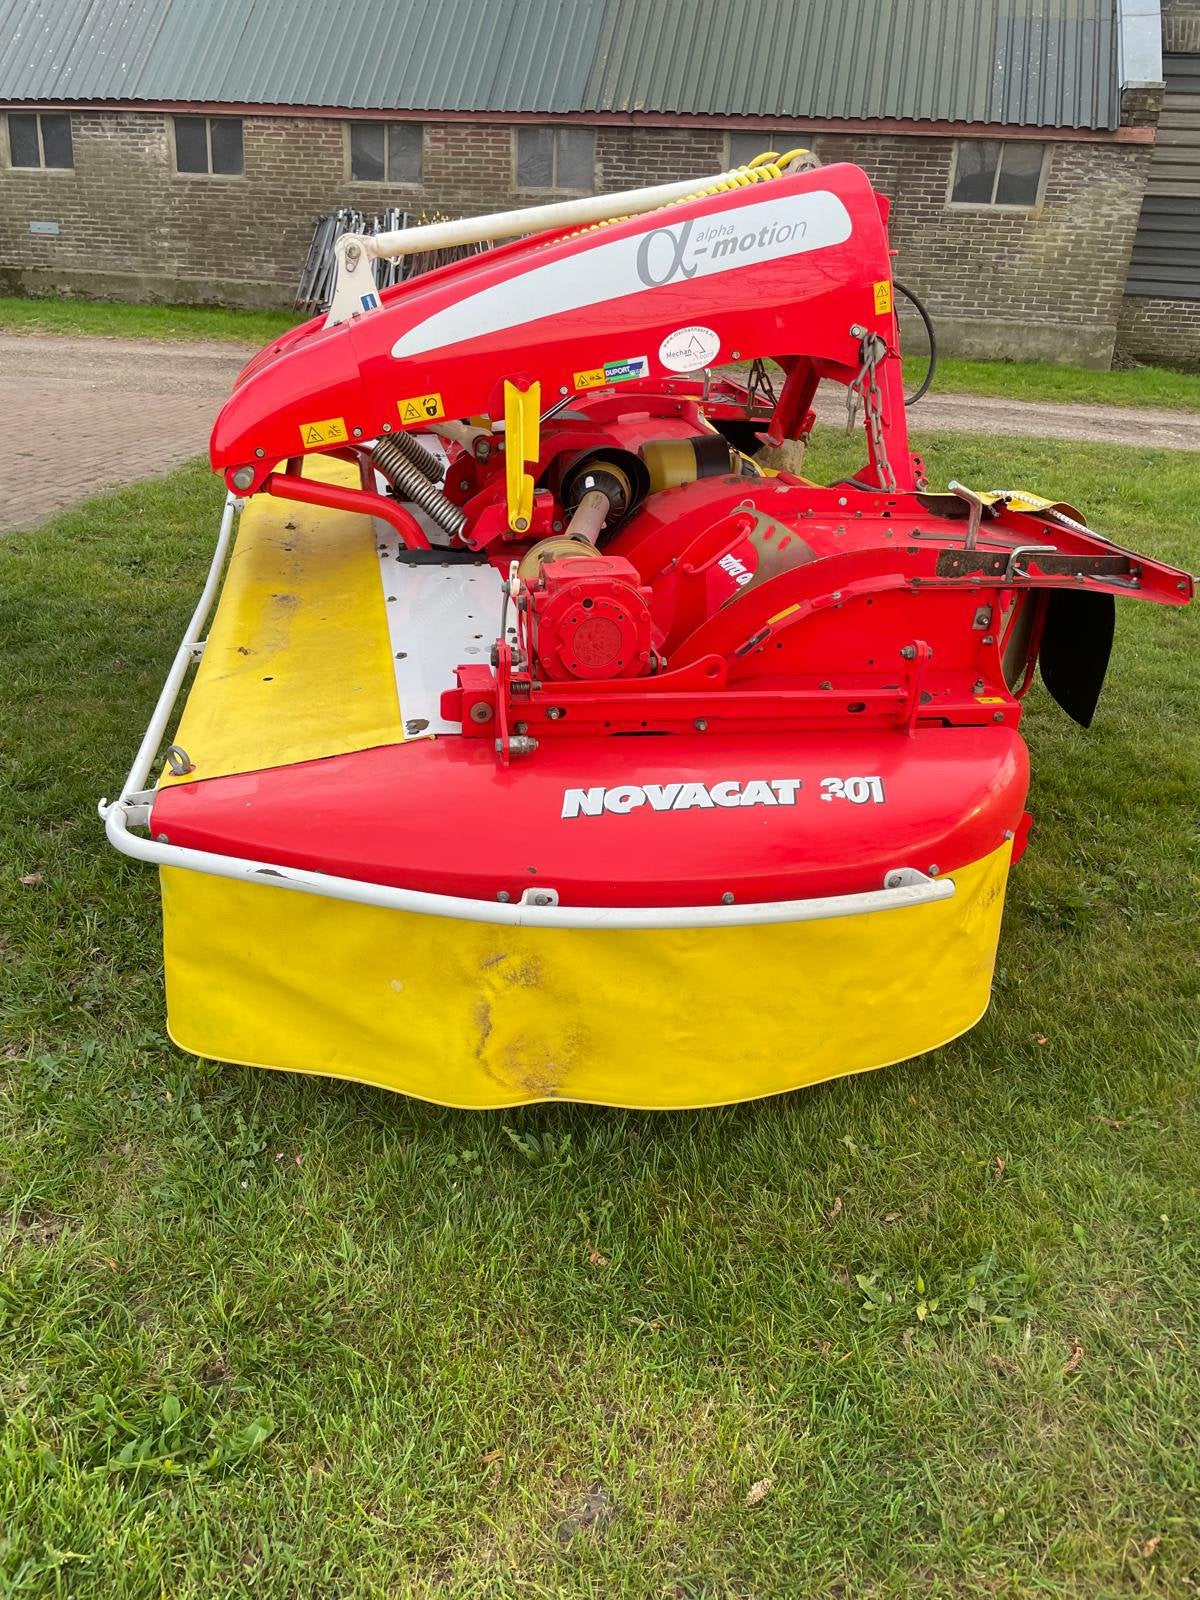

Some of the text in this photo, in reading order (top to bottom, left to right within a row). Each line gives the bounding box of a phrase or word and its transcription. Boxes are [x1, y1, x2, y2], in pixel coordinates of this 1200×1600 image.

[696, 224, 735, 243] alpha
[666, 348, 692, 359] Mechan
[605, 365, 631, 377] DUPORT
[561, 776, 885, 819] NOVACAT 301
